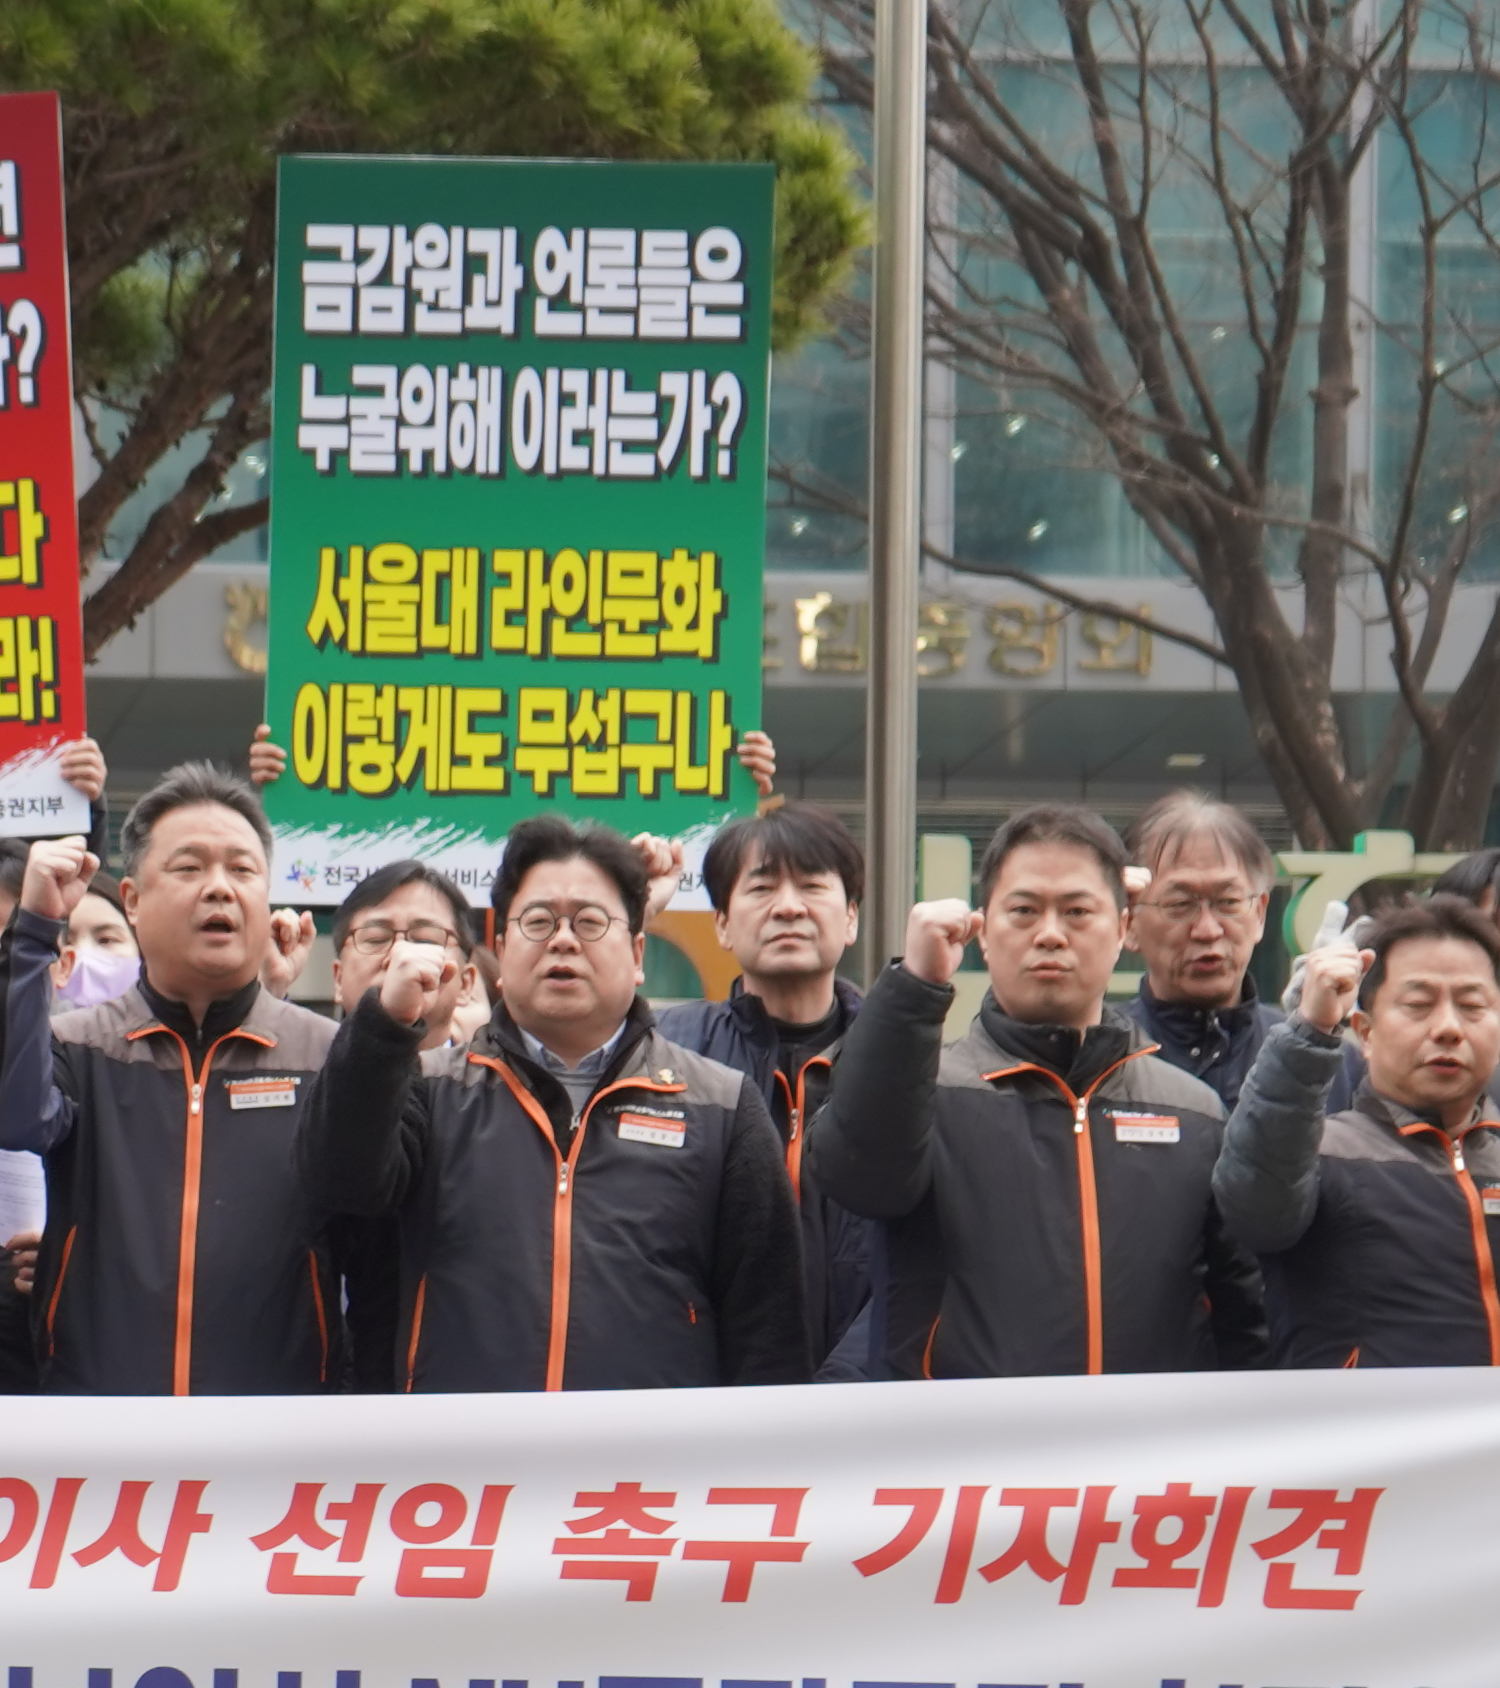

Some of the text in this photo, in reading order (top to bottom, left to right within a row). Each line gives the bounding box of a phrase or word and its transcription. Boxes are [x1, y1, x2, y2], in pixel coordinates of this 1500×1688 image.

[301, 223, 744, 338] 금감원과 언론들은
[297, 363, 742, 478] 누굴위해 이러는가?
[305, 542, 480, 655] 서울대
[490, 548, 723, 659] 라인문화
[292, 681, 733, 796] 이렇게도 무섭구나
[248, 1481, 516, 1600] 선임
[550, 1481, 810, 1604] 촉구
[851, 1481, 1386, 1612] 기자회견
